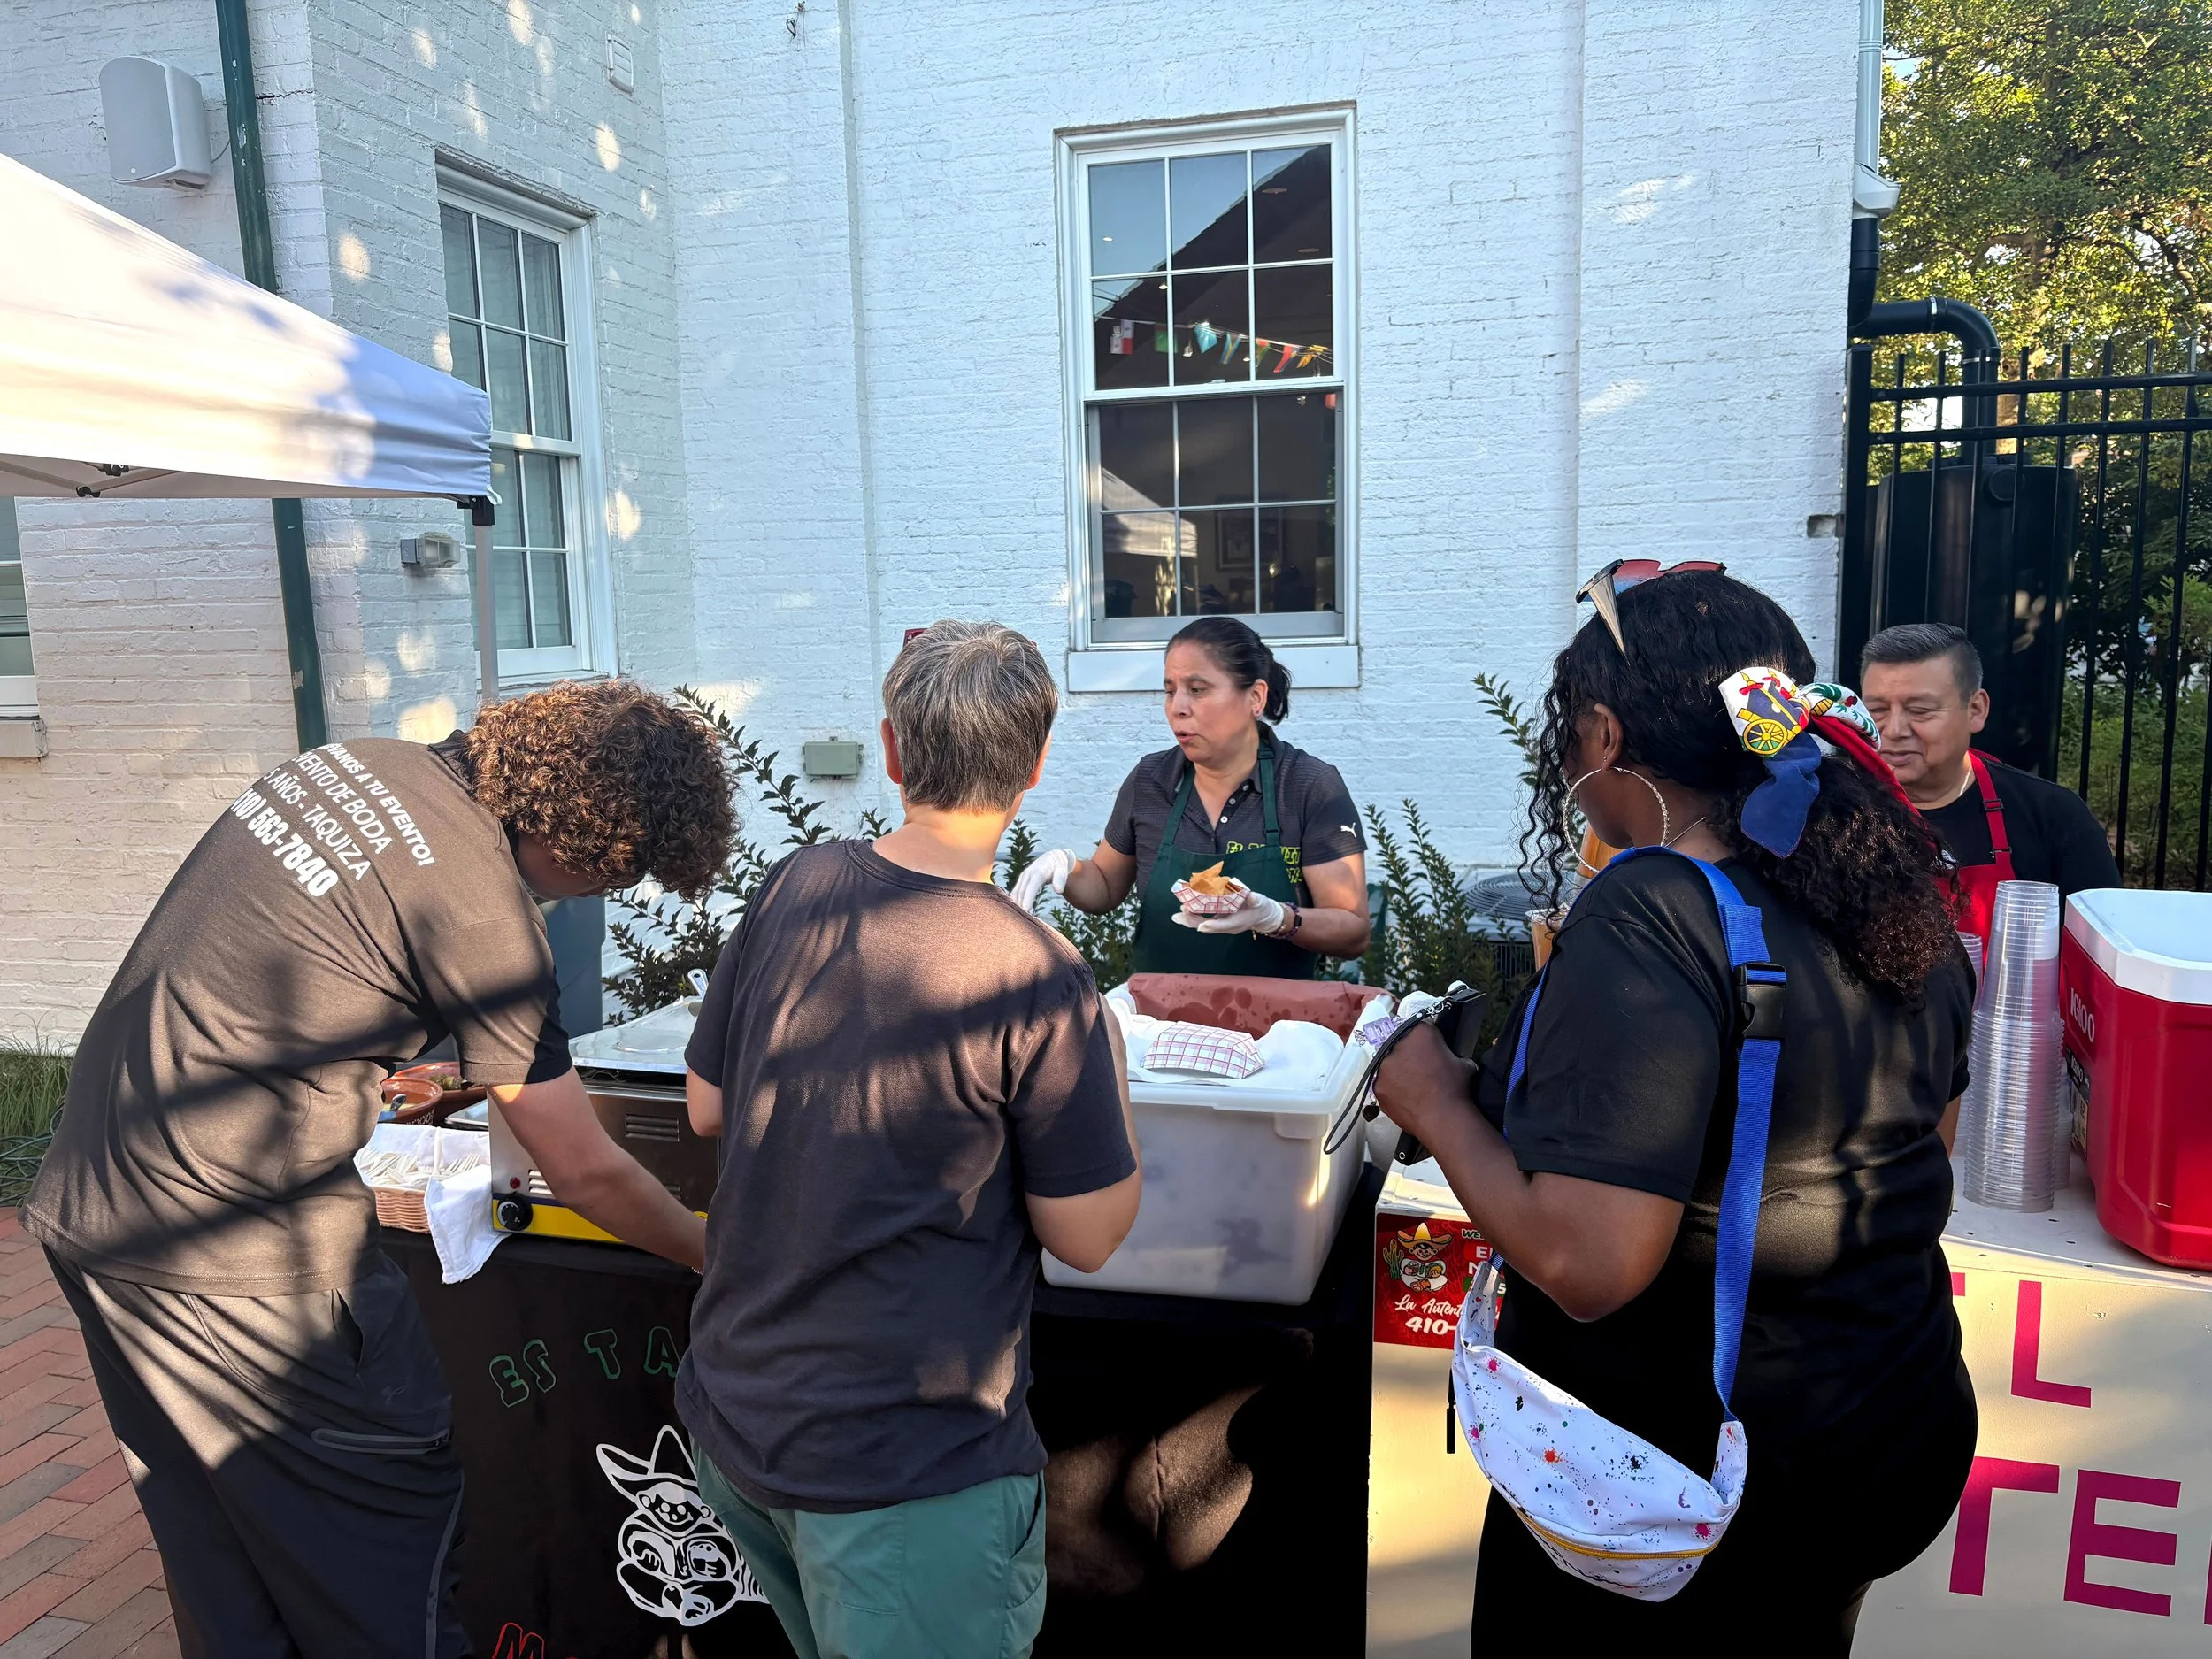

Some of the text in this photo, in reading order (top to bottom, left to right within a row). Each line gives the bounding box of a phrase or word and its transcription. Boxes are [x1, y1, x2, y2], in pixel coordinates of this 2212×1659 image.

[247, 806, 339, 897] 563-7840
[267, 772, 308, 805] AÑOS
[301, 803, 372, 881] TAQUIZA
[325, 782, 357, 803] DE
[342, 798, 393, 855] BODA
[355, 773, 373, 784] A
[365, 780, 390, 796] TU
[379, 795, 435, 866] EVENTO!
[1394, 1294, 1416, 1311] La
[1948, 1455, 2212, 1626] TE
